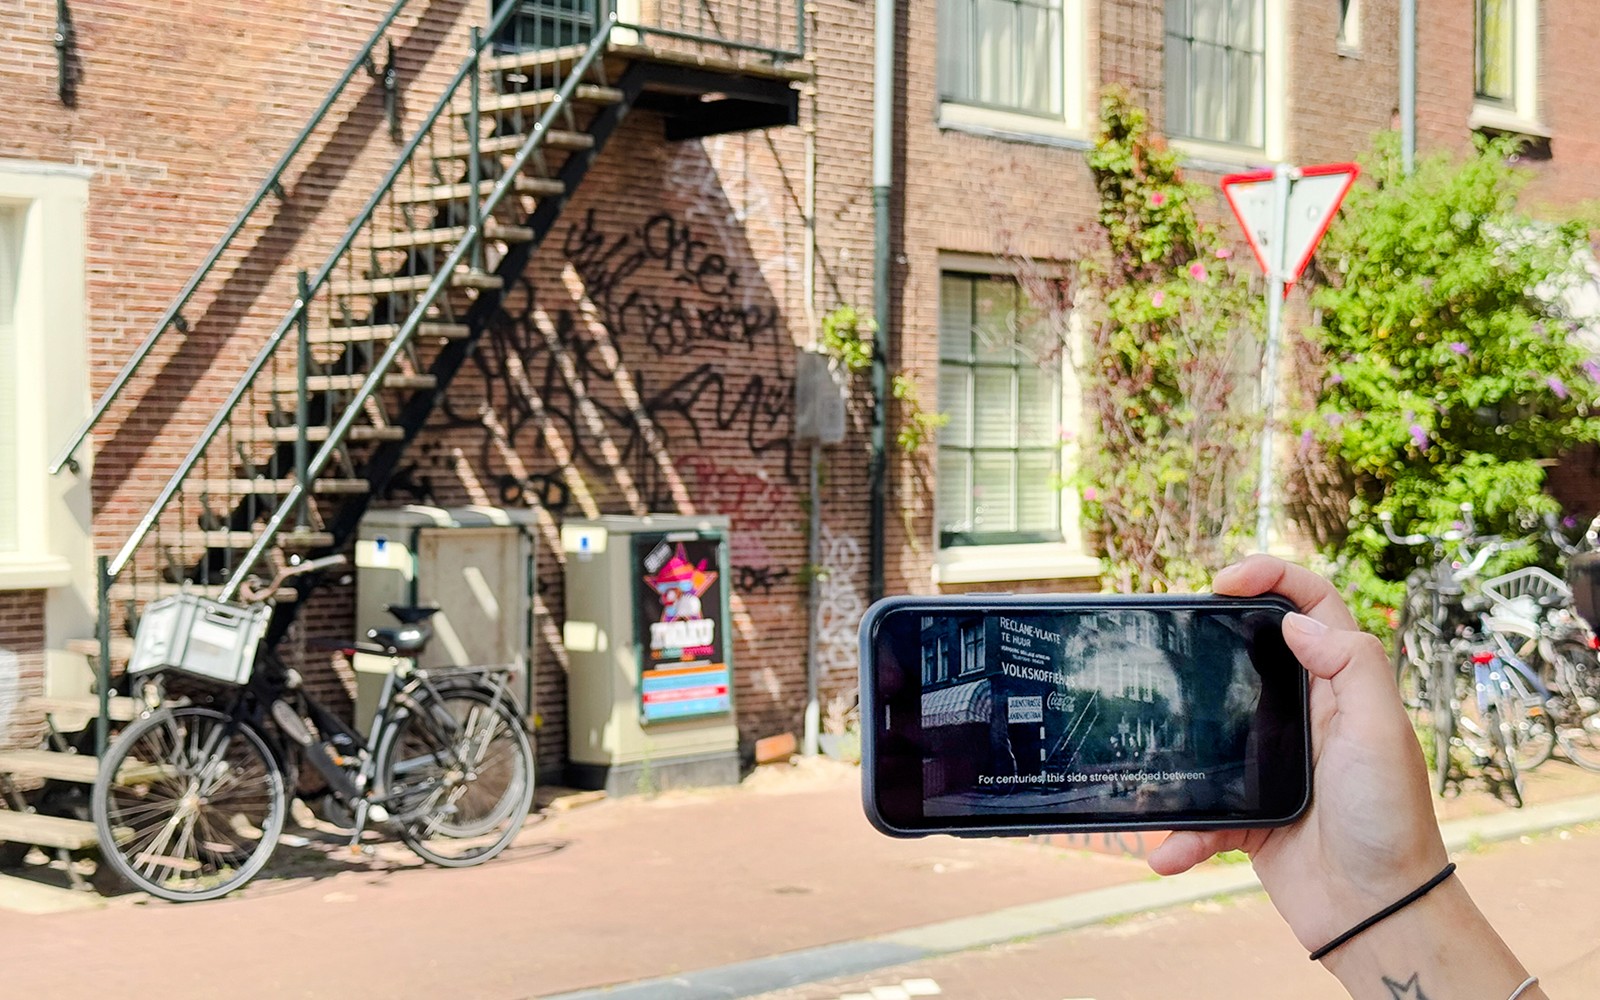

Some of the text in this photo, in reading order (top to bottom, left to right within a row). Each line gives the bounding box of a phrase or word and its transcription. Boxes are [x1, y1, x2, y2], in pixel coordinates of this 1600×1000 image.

[1001, 632, 1011, 643] TE
[978, 775, 994, 785] For
[1047, 772, 1065, 783] this
[1066, 772, 1088, 783] side
[1089, 772, 1118, 782] street
[1119, 770, 1161, 784] wedged
[1162, 770, 1206, 781] between
